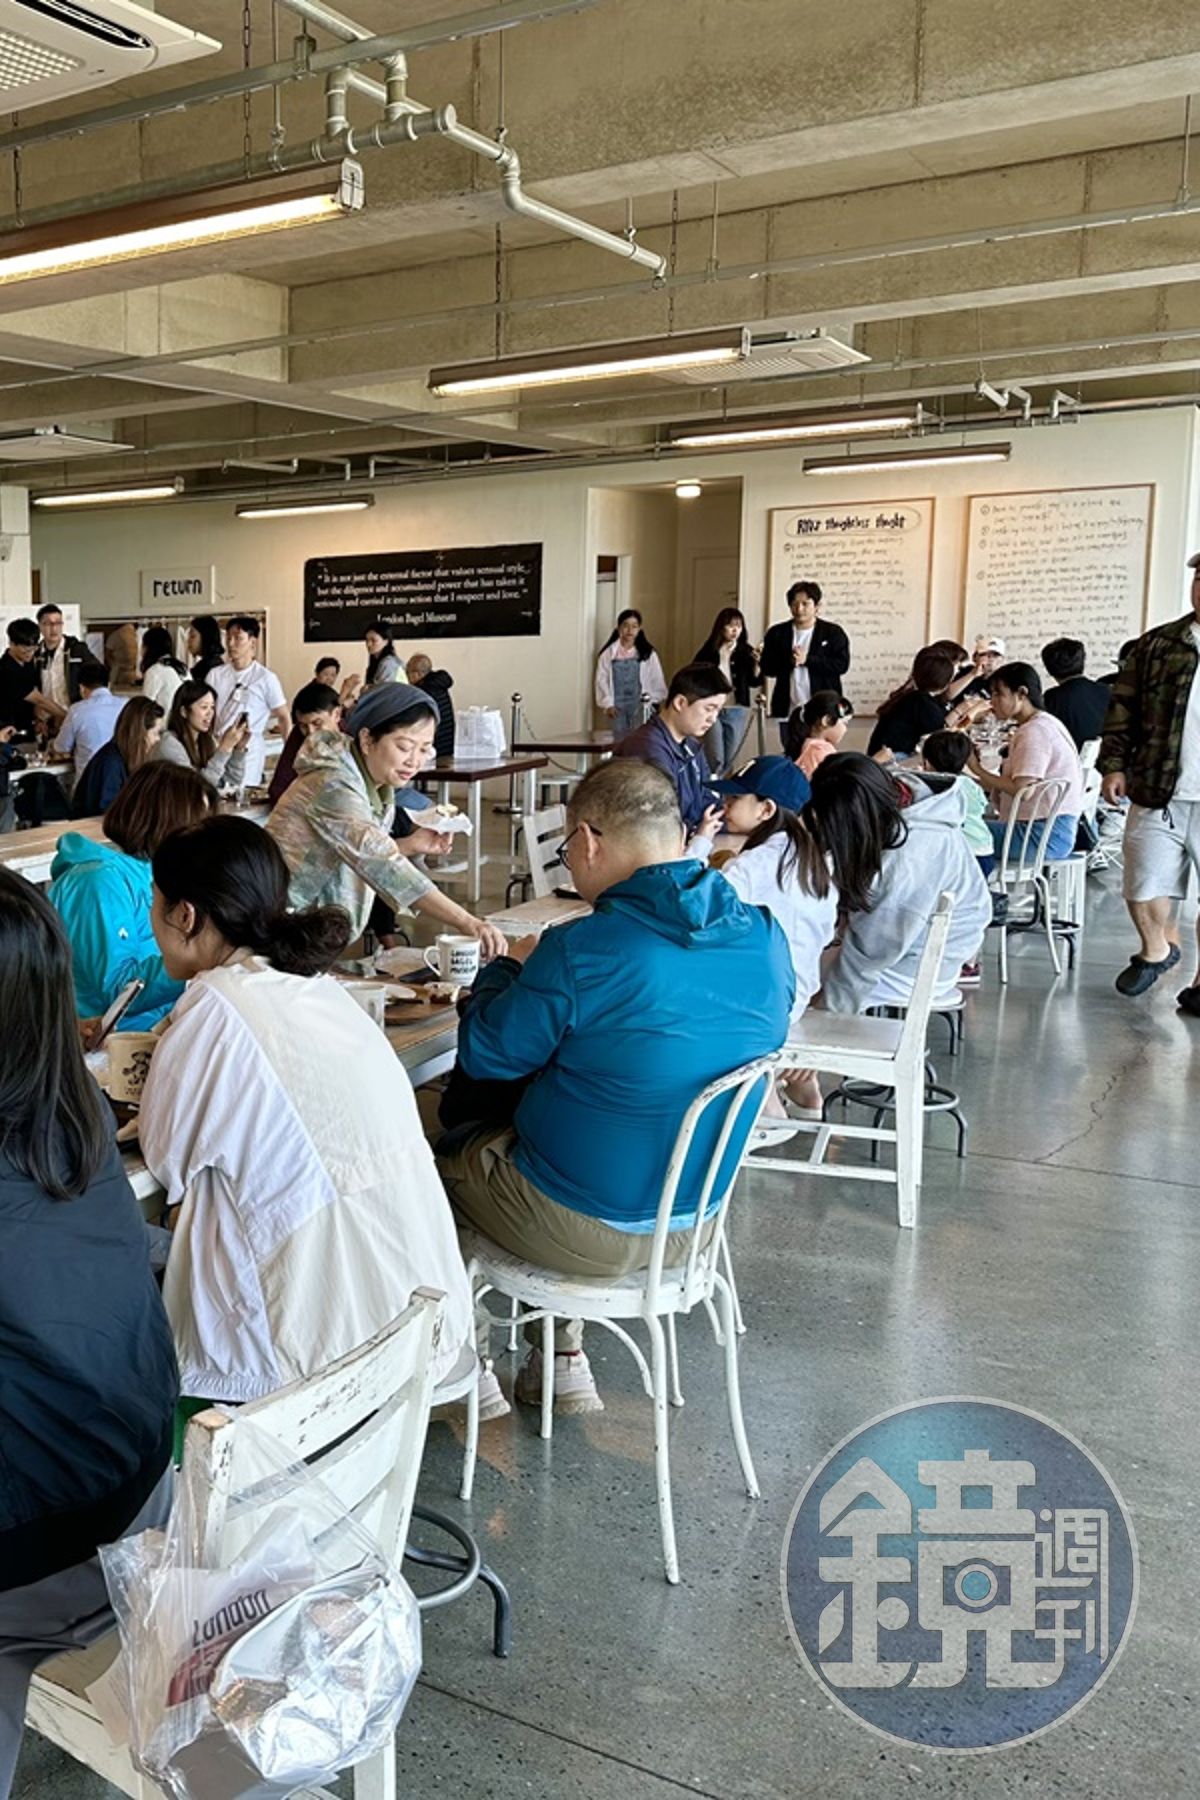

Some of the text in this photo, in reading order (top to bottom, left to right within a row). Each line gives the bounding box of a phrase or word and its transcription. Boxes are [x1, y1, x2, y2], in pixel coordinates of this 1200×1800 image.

[352, 572, 366, 584] just
[368, 571, 379, 581] the
[380, 569, 409, 580] external
[411, 568, 433, 578] factor
[434, 567, 449, 577] that
[451, 566, 475, 576] values
[153, 579, 203, 598] return
[330, 586, 342, 595] the
[375, 583, 389, 593] and
[437, 581, 461, 592] power
[464, 578, 479, 588] that
[480, 577, 494, 587] has
[495, 576, 517, 586] taken
[345, 597, 359, 607] and
[393, 596, 408, 605] into
[409, 594, 432, 604] action
[433, 593, 449, 603] that
[456, 592, 484, 604] respect
[486, 590, 500, 600] and
[425, 611, 457, 623] Museum
[193, 1589, 271, 1647] London
